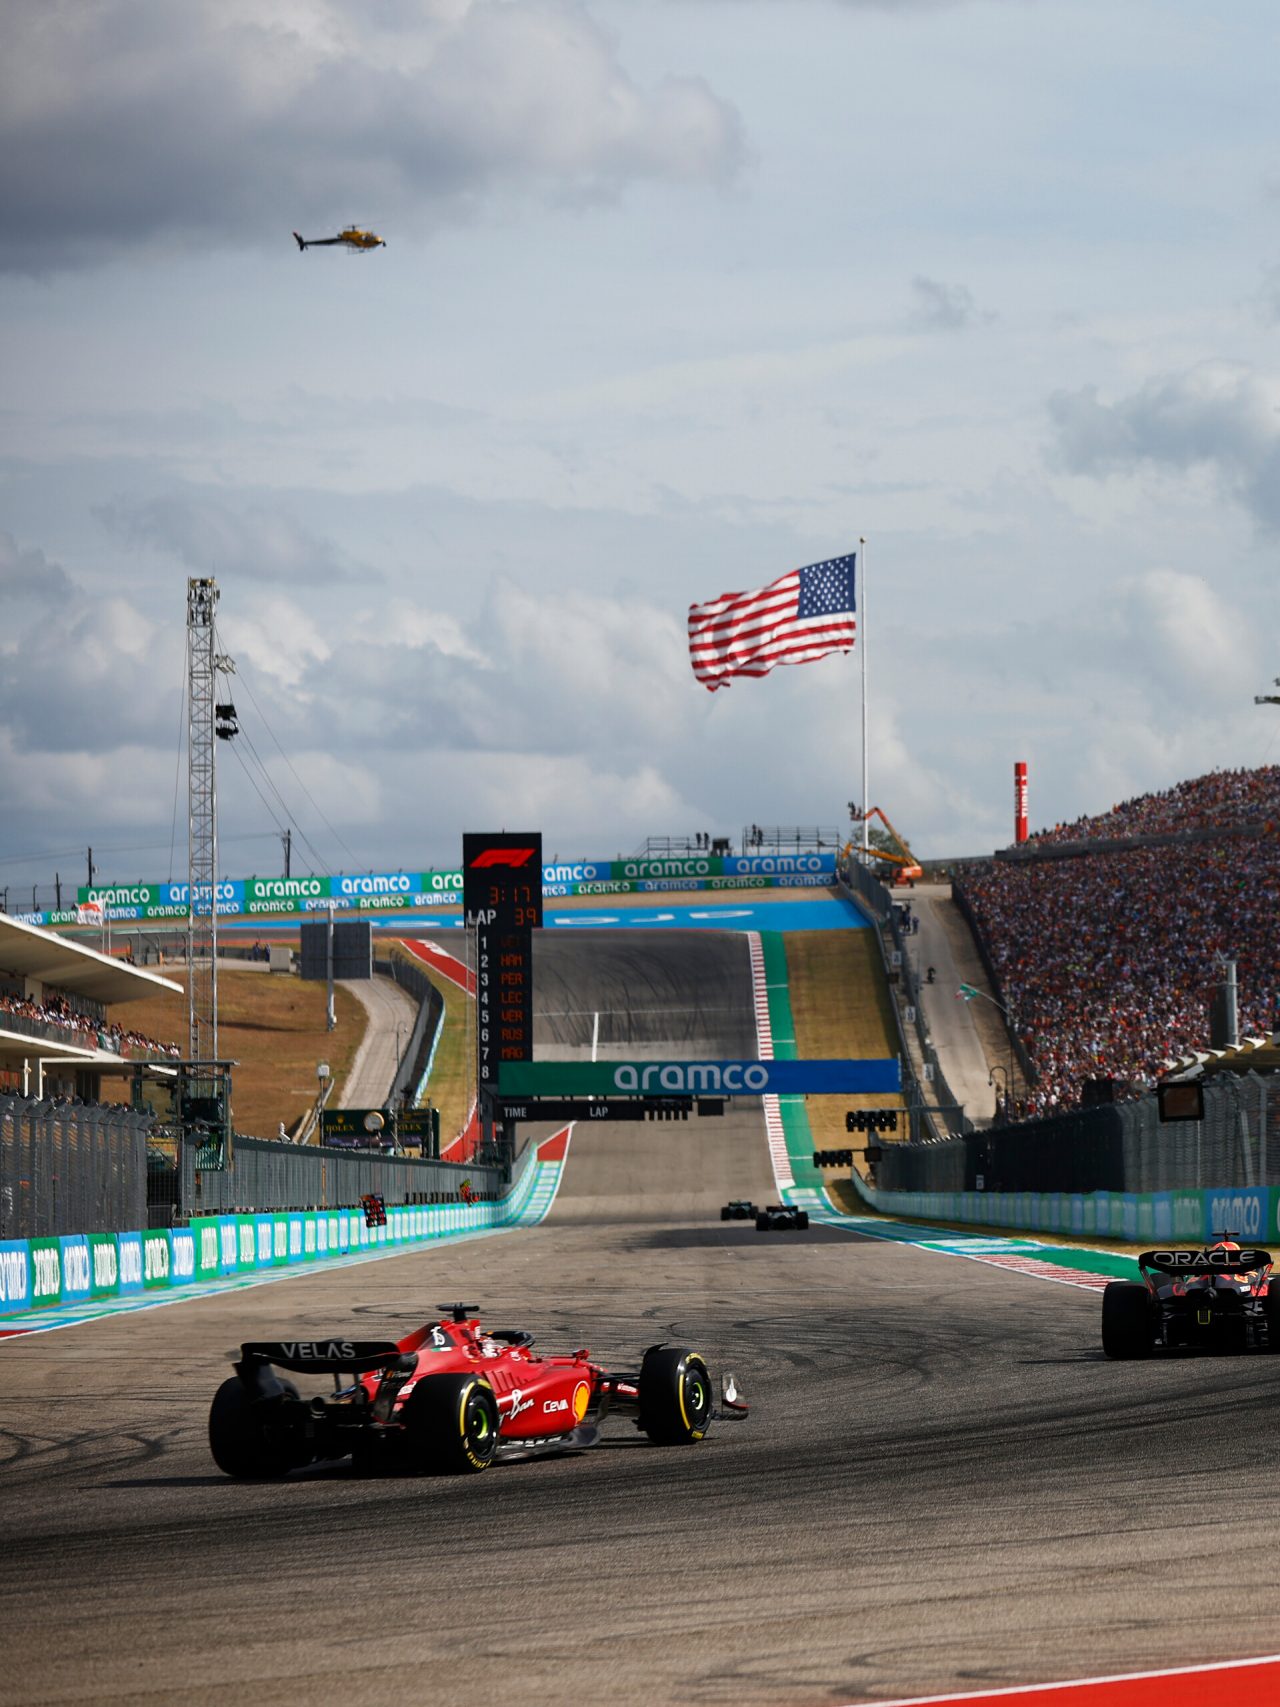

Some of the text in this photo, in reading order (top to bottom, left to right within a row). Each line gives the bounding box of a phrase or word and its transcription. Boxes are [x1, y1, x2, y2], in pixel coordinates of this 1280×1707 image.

[624, 859, 709, 878] aramco
[737, 855, 822, 873] aramco
[542, 864, 598, 882] amco
[341, 874, 411, 894] aramco
[431, 872, 464, 890] ara
[644, 879, 698, 891] aramco
[711, 878, 766, 889] aramco
[778, 875, 833, 887] aramco
[254, 879, 322, 898] aramco
[578, 882, 631, 895] aramco
[87, 887, 151, 905] aramco
[359, 895, 404, 908] aramco
[414, 892, 457, 906] aramco
[147, 905, 188, 917] aramco
[249, 900, 295, 913] aramco
[467, 909, 497, 926] LAP
[514, 907, 537, 926] 39
[481, 935, 488, 950] 1
[480, 954, 489, 969] 2
[480, 973, 489, 986] 3
[481, 991, 489, 1005] 4
[481, 1010, 490, 1023] 5
[481, 1028, 490, 1042] 6
[482, 1047, 490, 1060] 7
[481, 1065, 490, 1079] 8
[613, 1064, 770, 1091] aramco
[503, 1106, 609, 1118] TIME LAP
[1153, 1250, 1256, 1266] ORACLE
[280, 1342, 356, 1359] VELAS
